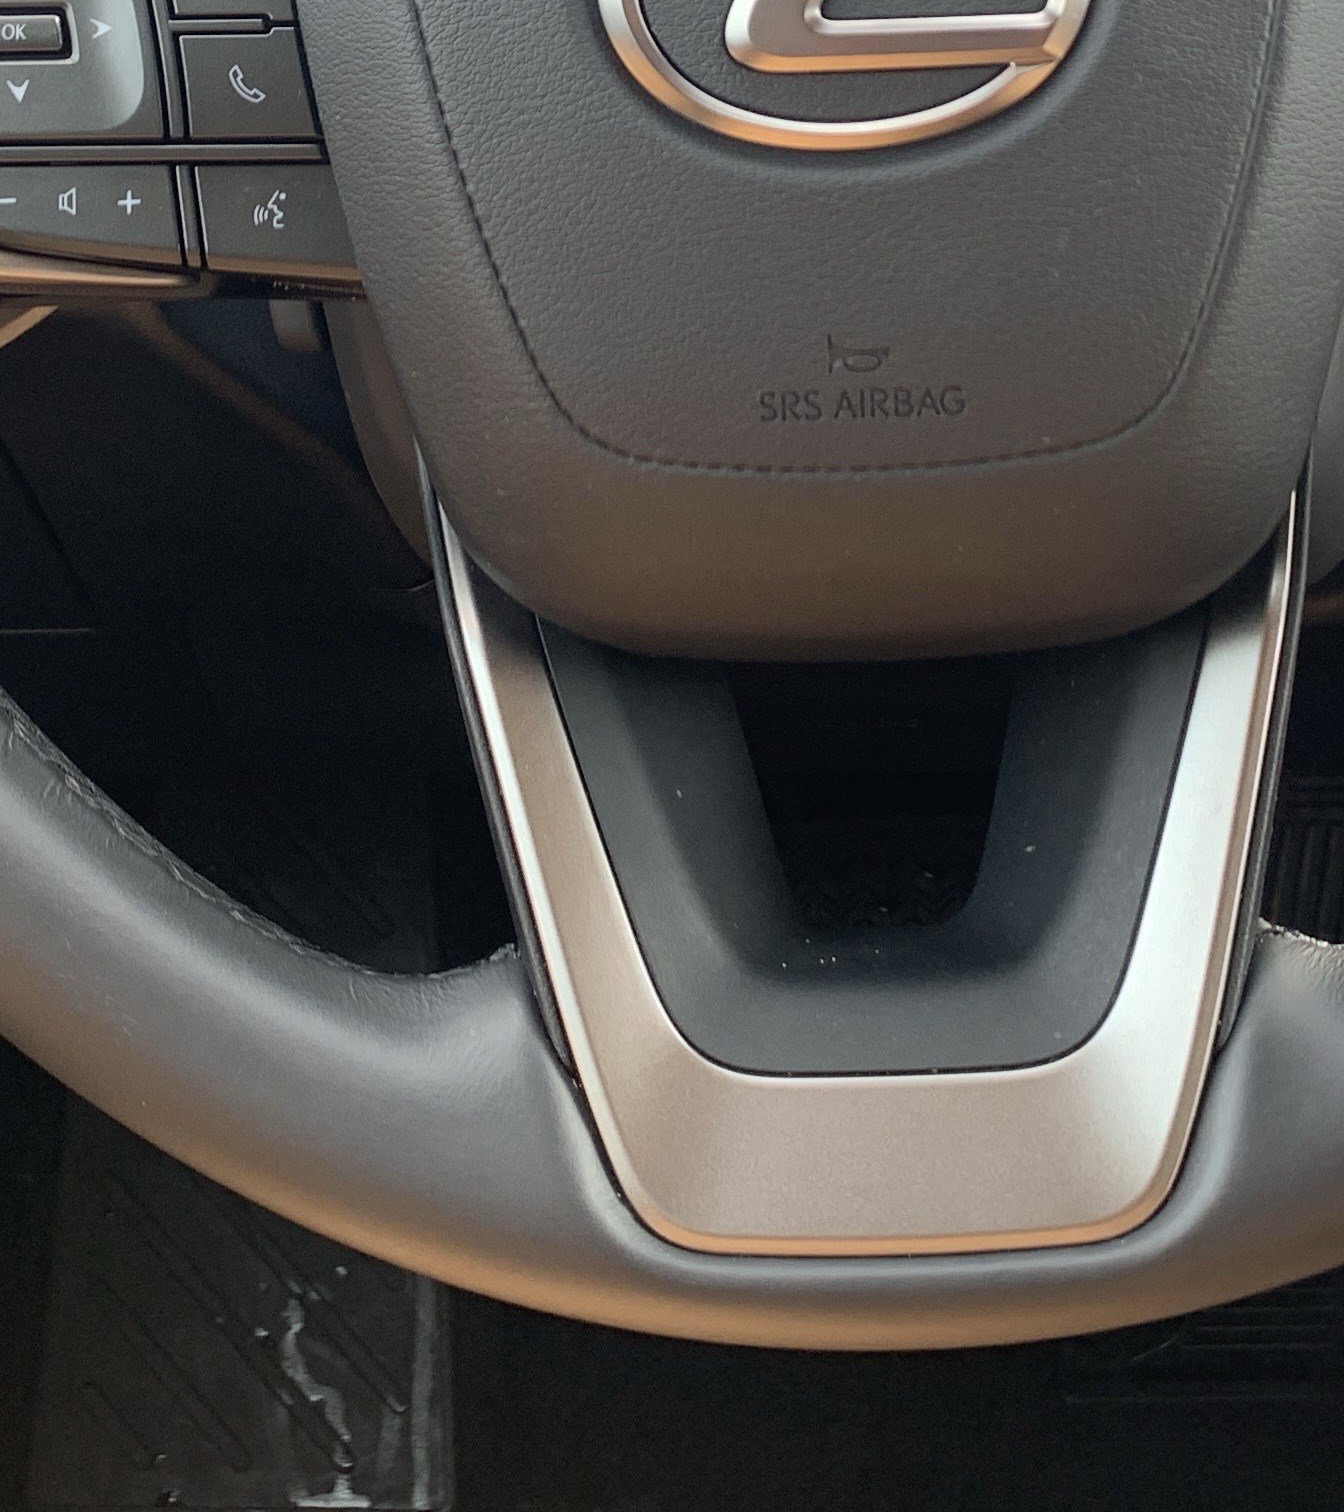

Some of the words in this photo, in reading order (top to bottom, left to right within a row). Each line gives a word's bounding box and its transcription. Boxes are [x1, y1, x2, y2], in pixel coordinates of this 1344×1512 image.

[0, 21, 27, 41] OK
[759, 389, 823, 422] SRS
[833, 384, 966, 418] AIRBAG
